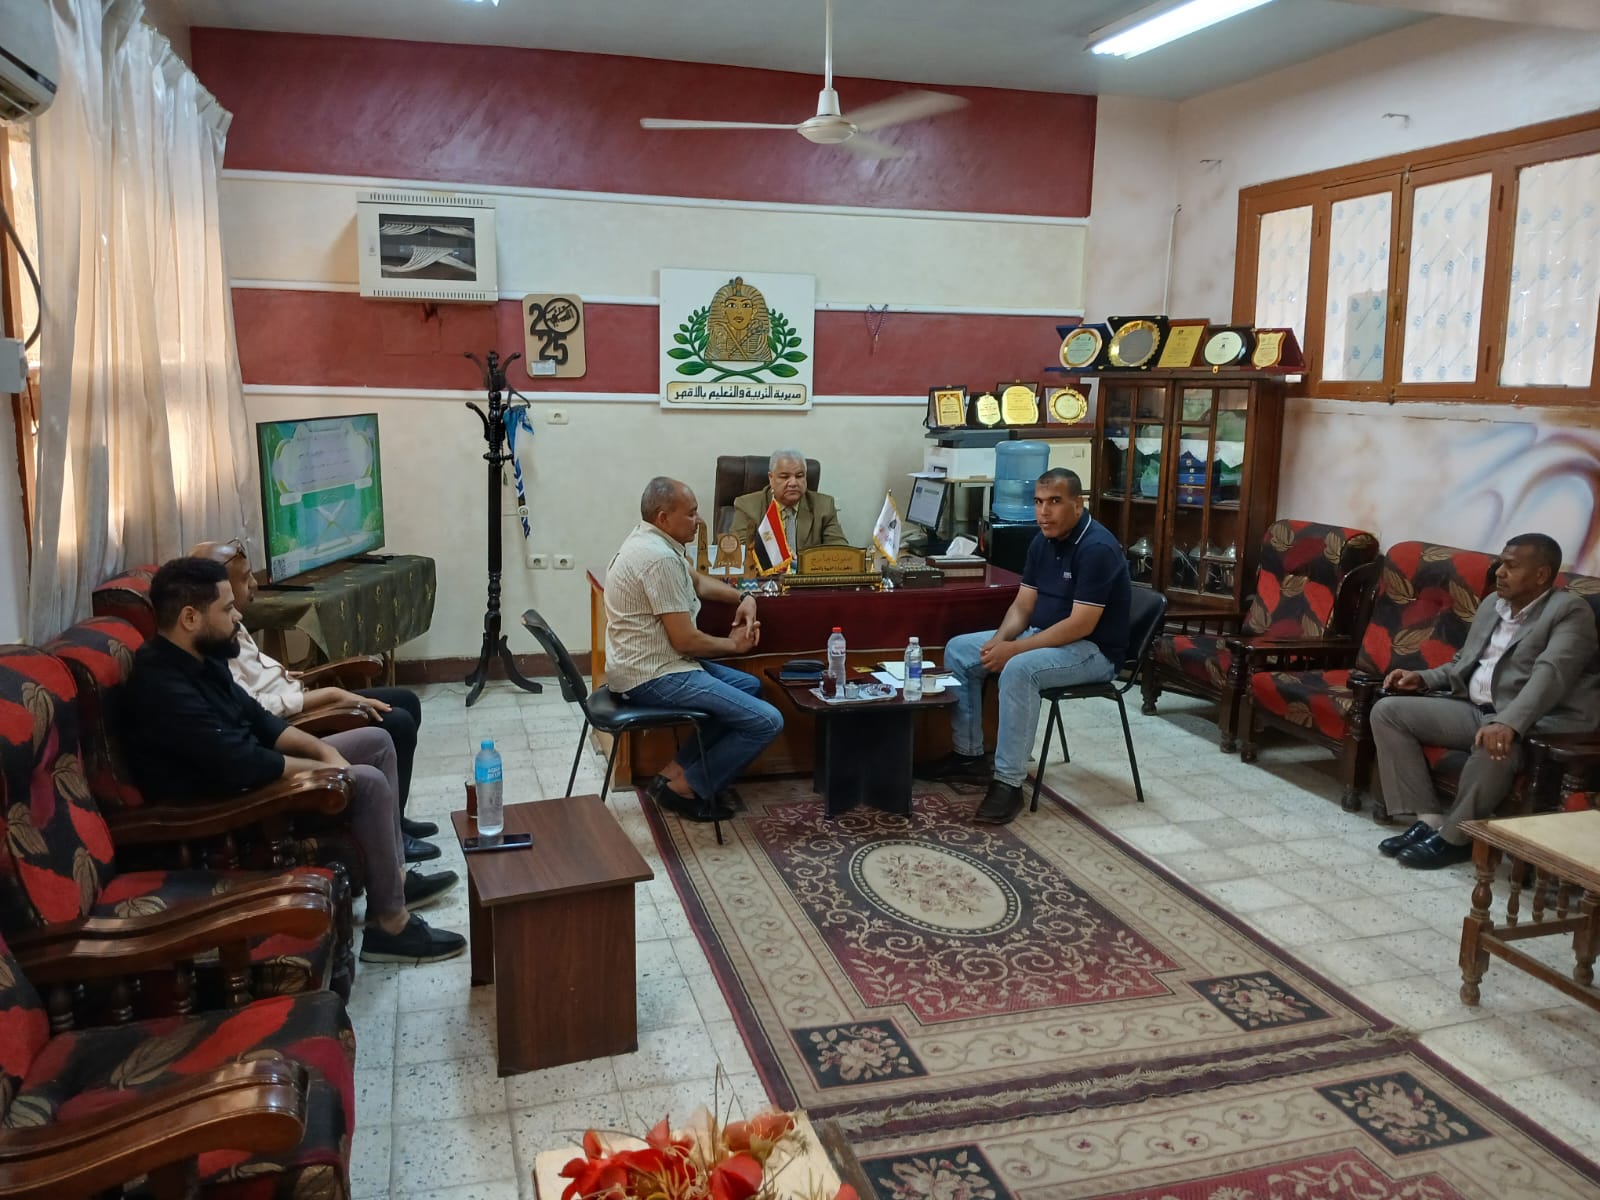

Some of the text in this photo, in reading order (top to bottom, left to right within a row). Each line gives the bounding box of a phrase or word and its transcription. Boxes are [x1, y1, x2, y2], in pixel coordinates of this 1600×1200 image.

[708, 385, 745, 401] والتعليم
[745, 385, 773, 401] التربية
[773, 389, 802, 401] مديرية
